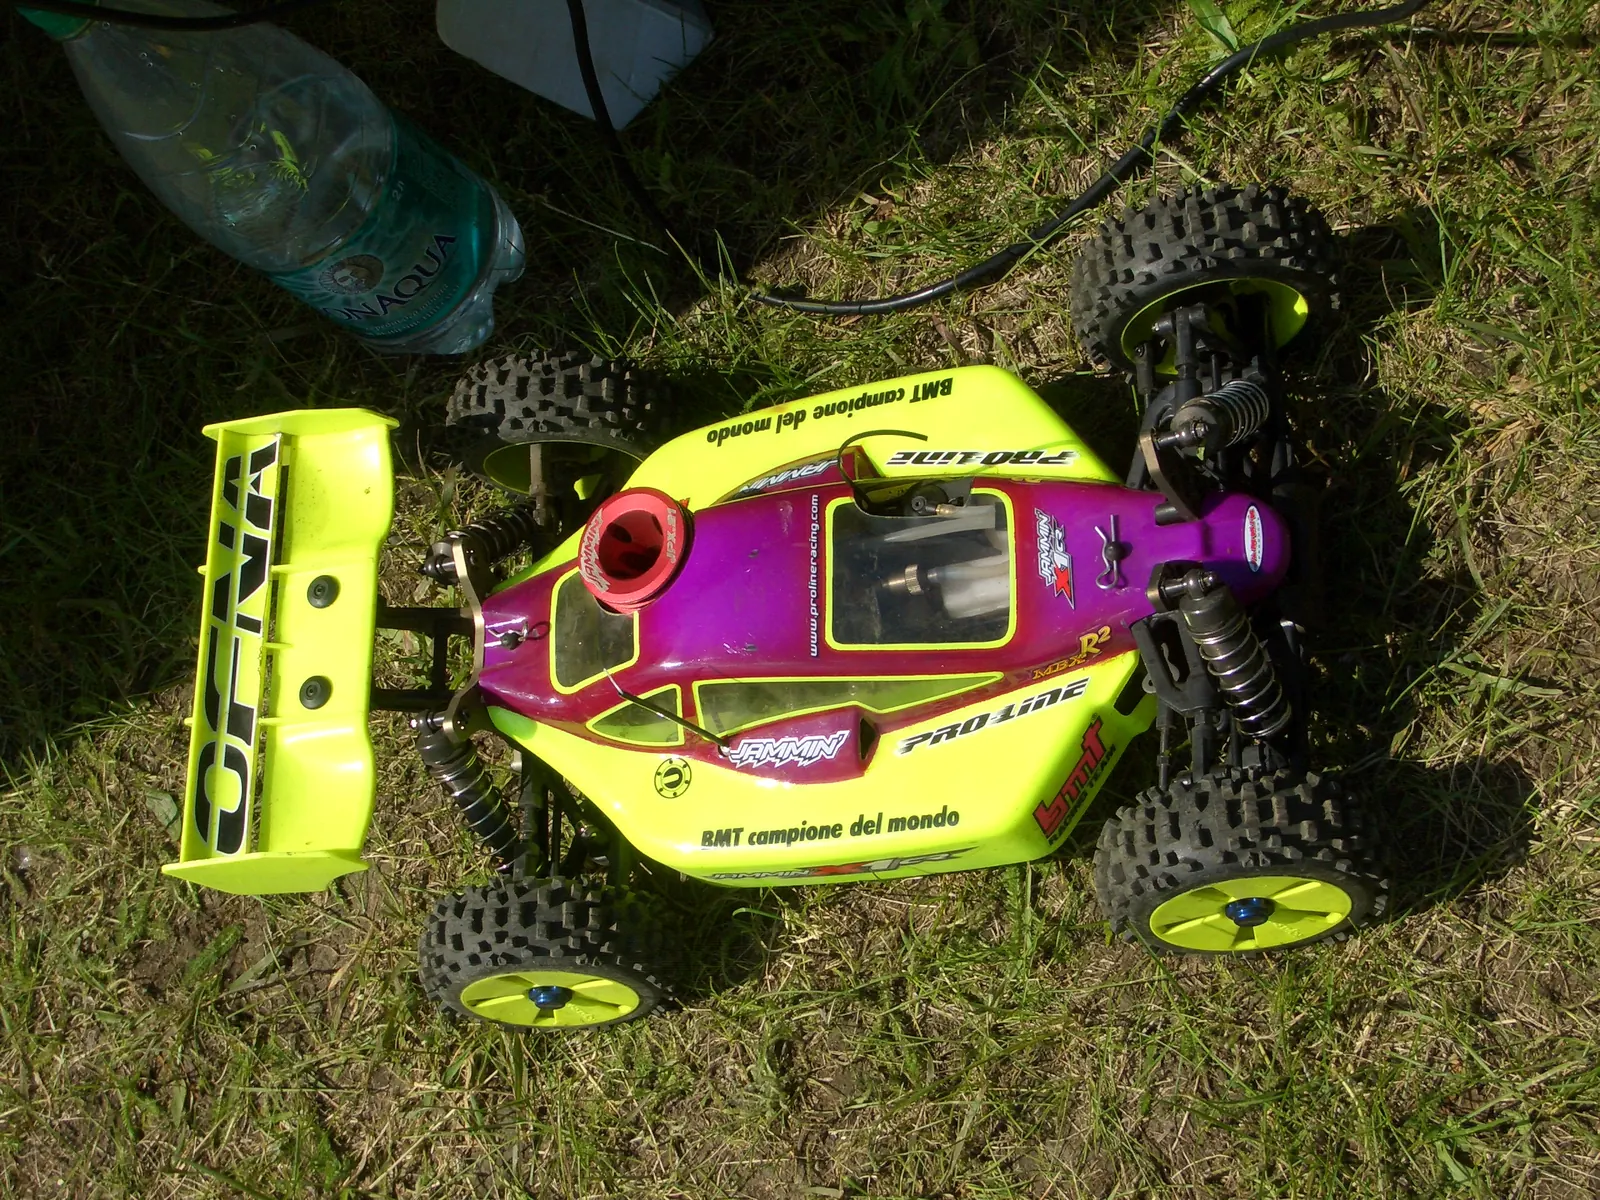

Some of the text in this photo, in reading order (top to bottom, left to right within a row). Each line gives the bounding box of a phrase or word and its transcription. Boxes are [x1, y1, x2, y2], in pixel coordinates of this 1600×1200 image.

[706, 377, 954, 447] BMT campione del mondo
[809, 494, 820, 657] www.prolineracing.com
[194, 434, 279, 855] OFNA
[700, 805, 960, 849] BMT campione del mondo
